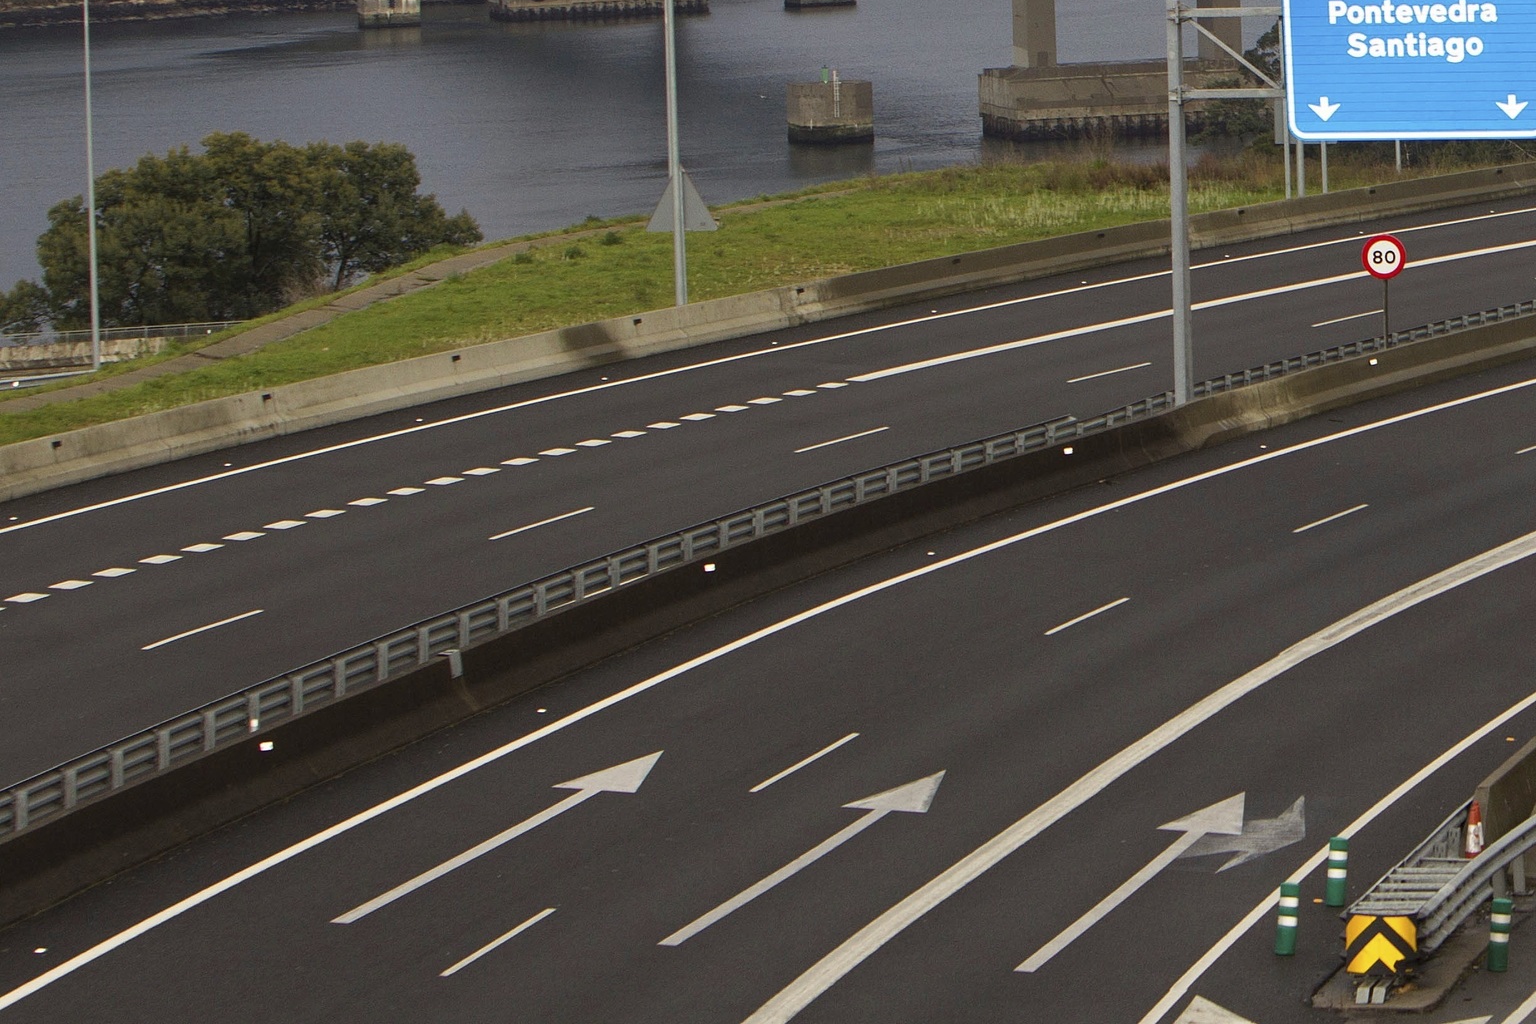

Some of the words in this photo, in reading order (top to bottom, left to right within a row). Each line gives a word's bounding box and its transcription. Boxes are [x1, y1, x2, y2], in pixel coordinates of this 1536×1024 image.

[1328, 0, 1498, 24] Pontevedra
[1347, 32, 1484, 63] Santiago
[1373, 250, 1396, 264] 80
